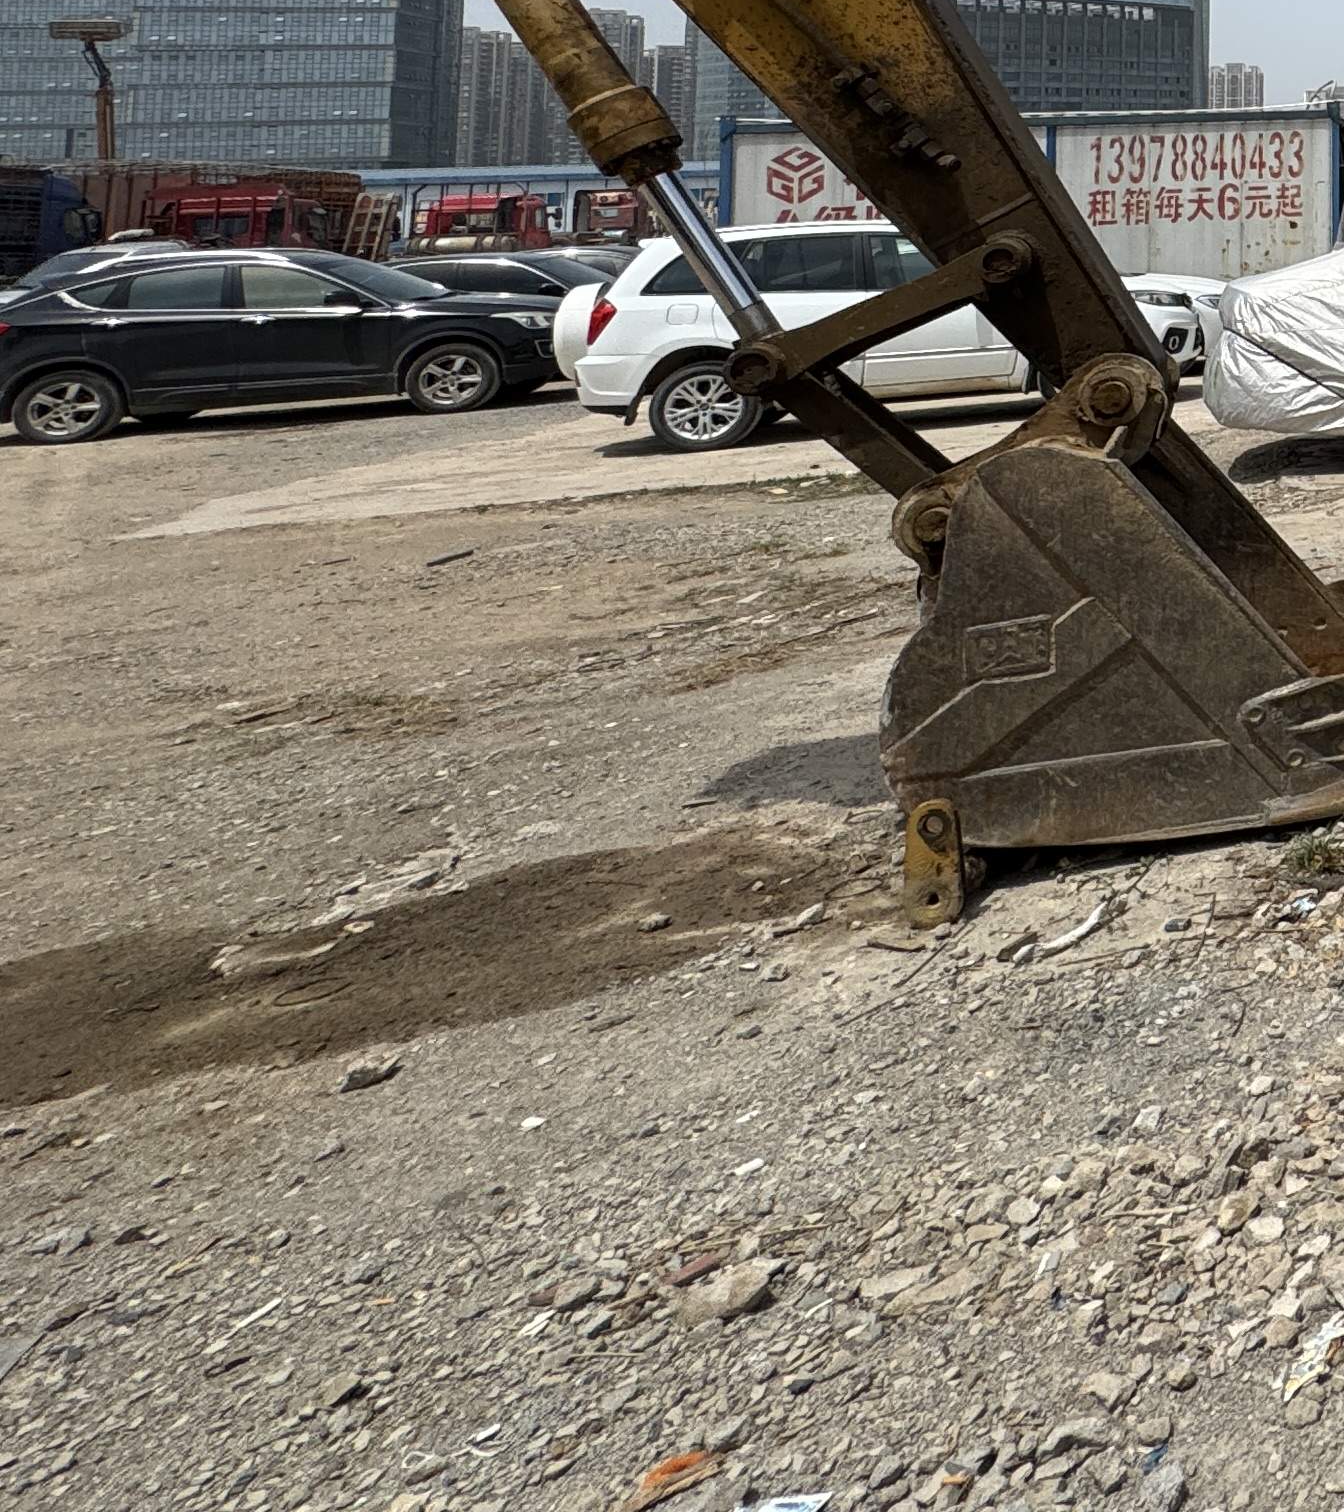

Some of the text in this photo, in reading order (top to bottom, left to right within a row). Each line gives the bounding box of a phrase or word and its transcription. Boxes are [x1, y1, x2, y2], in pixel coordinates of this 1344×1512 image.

[1089, 130, 1304, 185] 13978840433
[1087, 183, 1304, 227] 租箱每天6元起
